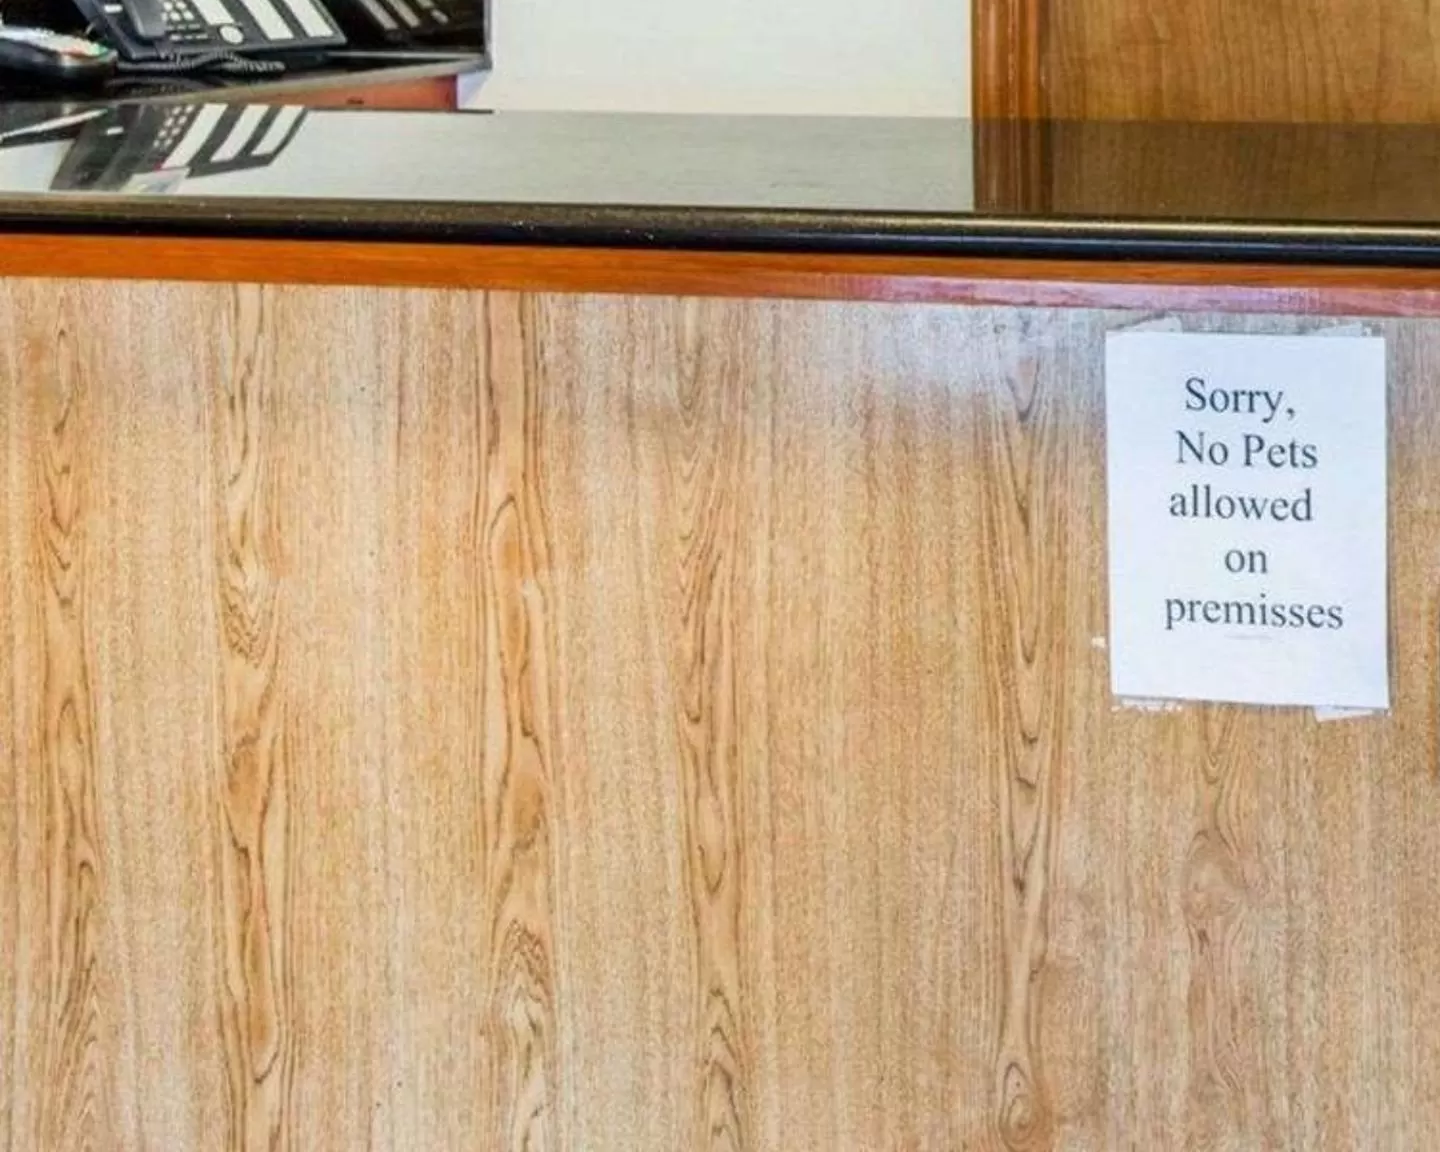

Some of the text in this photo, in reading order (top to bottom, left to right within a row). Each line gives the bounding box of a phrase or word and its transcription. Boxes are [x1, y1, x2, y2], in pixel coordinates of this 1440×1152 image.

[1185, 376, 1297, 421] Sorry,
[1176, 430, 1318, 472] No Pets
[1168, 487, 1314, 523] allowed
[1224, 548, 1269, 576] on
[1165, 594, 1345, 632] premisses
